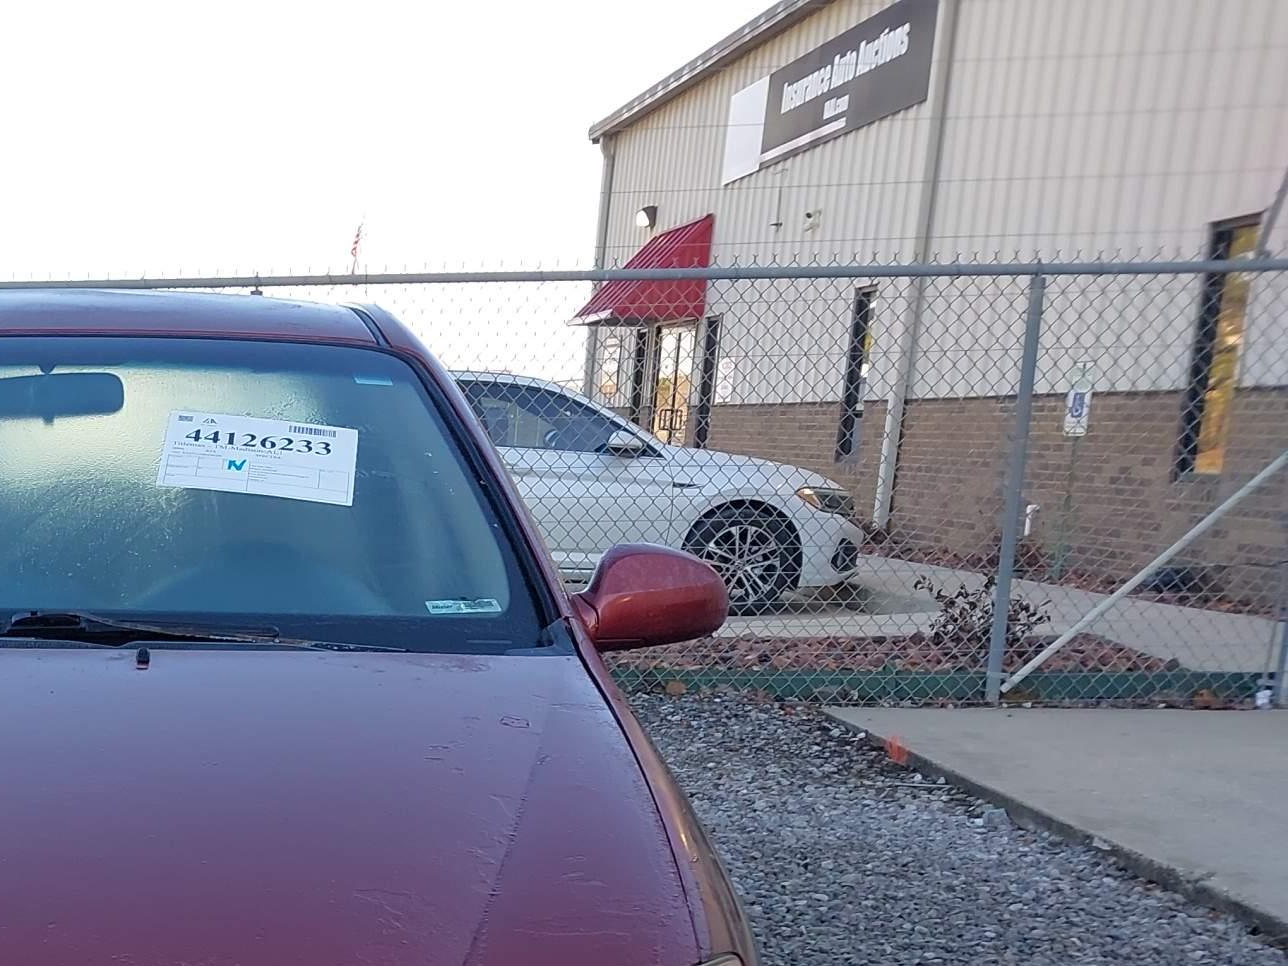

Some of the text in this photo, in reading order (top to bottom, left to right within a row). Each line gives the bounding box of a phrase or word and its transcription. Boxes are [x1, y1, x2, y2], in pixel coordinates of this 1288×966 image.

[780, 63, 832, 115] Insurance
[829, 48, 857, 90] Auto
[855, 21, 911, 77] Auctions
[185, 428, 332, 456] 44126233
